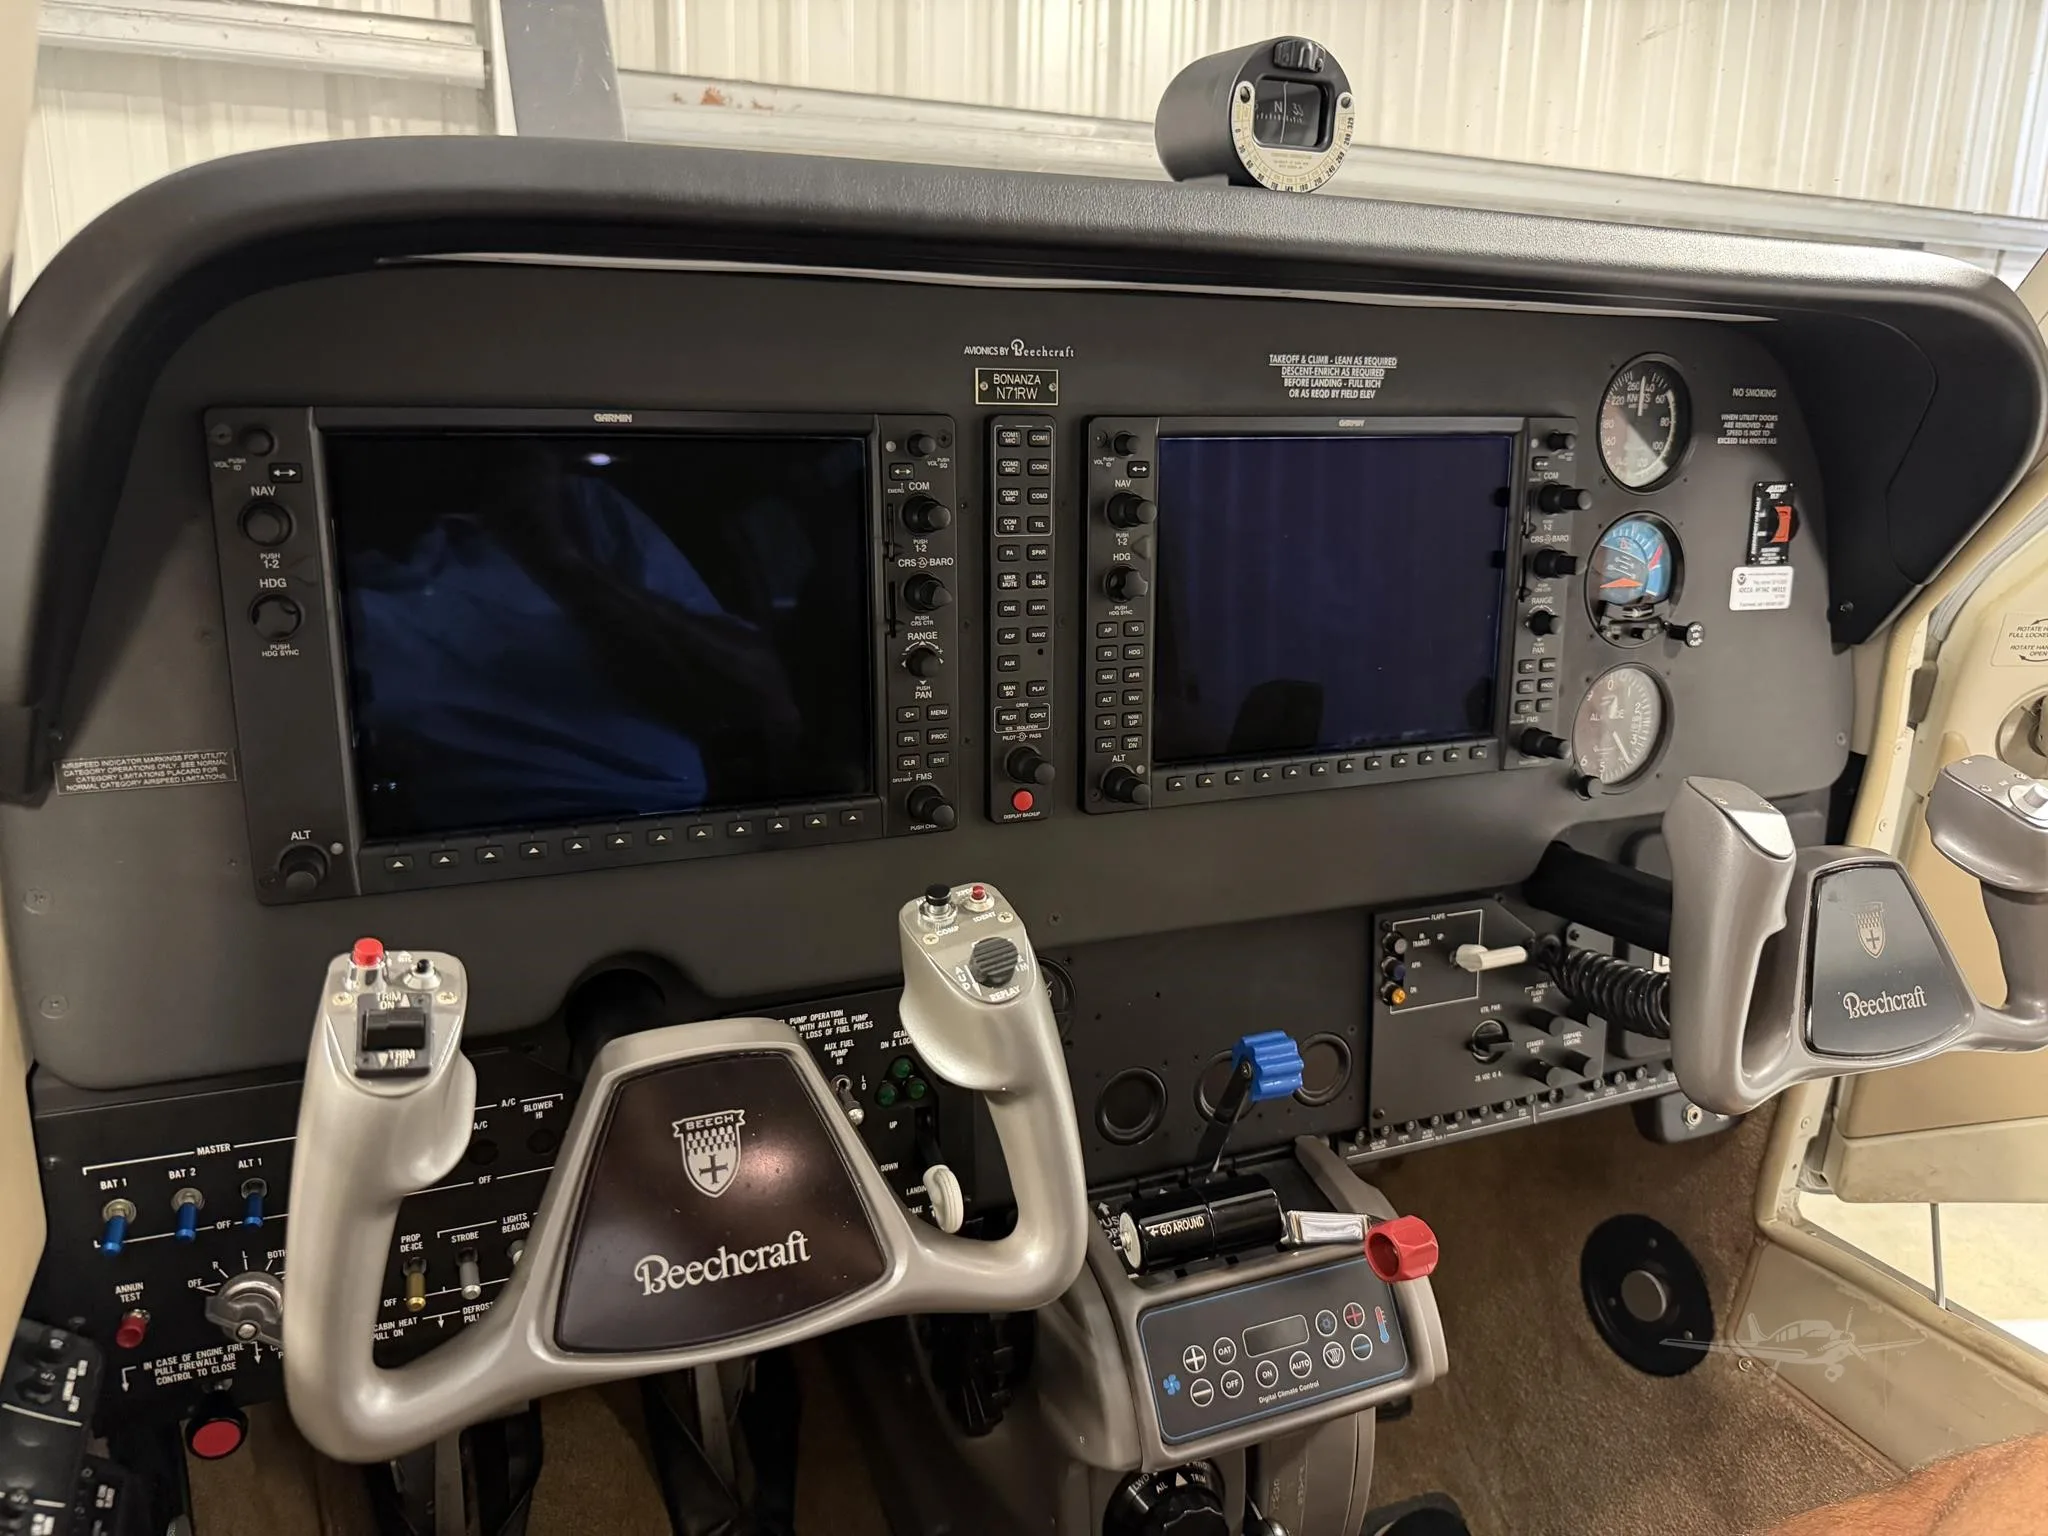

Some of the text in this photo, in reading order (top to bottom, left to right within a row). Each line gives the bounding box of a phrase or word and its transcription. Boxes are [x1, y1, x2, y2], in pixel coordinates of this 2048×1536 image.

[1274, 101, 1283, 113] N
[1327, 165, 1336, 176] 240
[964, 339, 1074, 357] AVIONICS BY Beechcraft
[1269, 354, 1300, 364] TAKEOFF
[1301, 355, 1306, 364] &
[1307, 355, 1329, 364] CLIMB
[1335, 356, 1352, 365] LEAN
[1354, 356, 1362, 365] AS
[1364, 356, 1397, 366] REQUIRED
[1281, 366, 1385, 377] DESCENT-ENRICH AS REQUIRED
[993, 374, 1041, 385] BONANZA
[1284, 378, 1309, 387] BEFORE
[1311, 378, 1342, 388] LANDING
[1348, 379, 1364, 388] FULL
[1365, 379, 1381, 388] RICH
[996, 387, 1038, 400] N71RW
[1289, 389, 1376, 399] OR AS REQD BY FIELD ELEV
[1733, 388, 1776, 398] NO SMOKING
[594, 413, 632, 422] GARMIN
[1652, 442, 1664, 450] 100
[1544, 472, 1559, 480] COM
[251, 486, 276, 496] NAV
[909, 482, 930, 490] COM
[929, 558, 954, 566] BARO
[1113, 553, 1131, 561] HDG
[264, 560, 279, 569] 1-2
[898, 559, 916, 567] CRS
[260, 579, 287, 588] HDG
[907, 632, 938, 640] RANGE
[1608, 680, 1613, 690] 0
[915, 691, 932, 699] PAN
[62, 761, 100, 769] AIRSPEED
[102, 758, 141, 767] INDICATOR
[143, 755, 182, 763] MARKINGS
[1112, 754, 1126, 762] ALT
[1580, 755, 1588, 766] 6
[63, 768, 106, 777] CATEGORY
[108, 764, 156, 773] OPERATIONS
[1600, 761, 1605, 772] 5
[76, 774, 118, 783] CATEGORY
[120, 771, 166, 780] LIMITATIONS
[167, 768, 201, 776] PLACARD
[916, 773, 932, 781] FMS
[66, 773, 226, 791] NORMAL CATEGORY AIRSPEED LIMITATIONS
[290, 830, 312, 841] ALT
[973, 912, 996, 923] IDENT
[376, 991, 401, 1002] TRIM
[989, 985, 1021, 1002] REPLAY
[1843, 985, 1928, 1020] Beechcraft
[790, 1009, 844, 1025] PUMP OPERATION
[800, 1014, 869, 1031] WITH AUX FUEL PUMP
[806, 1030, 822, 1039] LOSS
[836, 1026, 850, 1034] FUEL
[854, 1021, 874, 1031] PRESS
[824, 1042, 837, 1051] AUX
[388, 1049, 416, 1060] TRIM
[831, 1049, 848, 1058] PUMP
[501, 1098, 516, 1108] A/C
[524, 1101, 553, 1113] BLOWER
[474, 1121, 488, 1130] A/C
[686, 1114, 734, 1130] BEECH
[889, 1121, 897, 1129] UP
[197, 1144, 231, 1156] MASTER
[238, 1158, 262, 1169] ALT 1
[881, 1162, 898, 1172] DOWN
[169, 1167, 197, 1180] BAT 2
[100, 1178, 127, 1190] BAT 1
[479, 1175, 492, 1185] OFF
[503, 1213, 528, 1224] LIGHTS
[216, 1220, 232, 1230] OFF
[502, 1221, 530, 1234] BEACON
[1160, 1216, 1205, 1237] GO AROUND
[401, 1233, 421, 1243] PROP
[451, 1231, 480, 1243] STROBE
[401, 1242, 423, 1252] DE-ICE
[634, 1230, 812, 1296] Beechcraft
[115, 1282, 144, 1294] ANNUN
[187, 1278, 203, 1288] OFF
[121, 1293, 141, 1303] TEST
[384, 1298, 397, 1308] OFF
[144, 1343, 244, 1370] IN CASE OF ENGINE FIRE
[1218, 1346, 1231, 1356] OAT
[155, 1353, 236, 1377] PULL FIREWALL AIR
[1292, 1359, 1310, 1370] AUTO
[156, 1362, 236, 1386] CONTROL TO CLOSE
[1262, 1370, 1273, 1379] ON
[1226, 1379, 1239, 1389] OFF
[1258, 1381, 1319, 1404] Digital Climate Control
[1132, 1473, 1150, 1491] LWD
[1156, 1482, 1168, 1494] AIL
